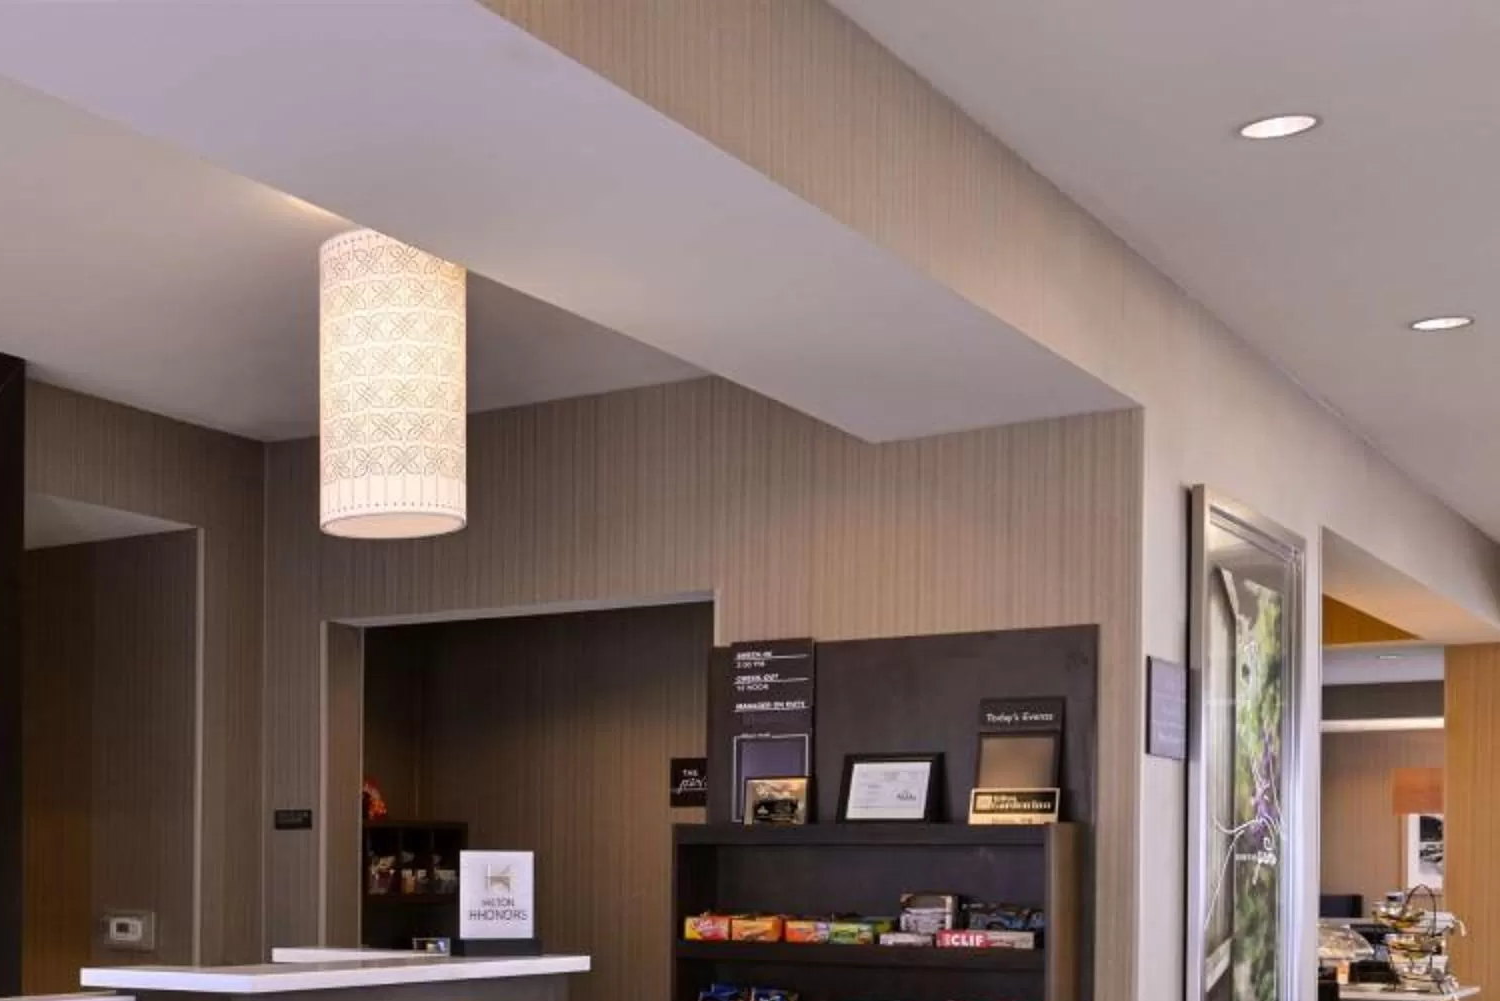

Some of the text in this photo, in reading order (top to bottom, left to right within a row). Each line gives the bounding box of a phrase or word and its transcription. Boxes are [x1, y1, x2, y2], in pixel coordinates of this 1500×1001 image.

[682, 769, 699, 777] THE
[481, 898, 515, 907] HILTON
[468, 908, 529, 921] HHONORS
[950, 933, 985, 947] CLIF
